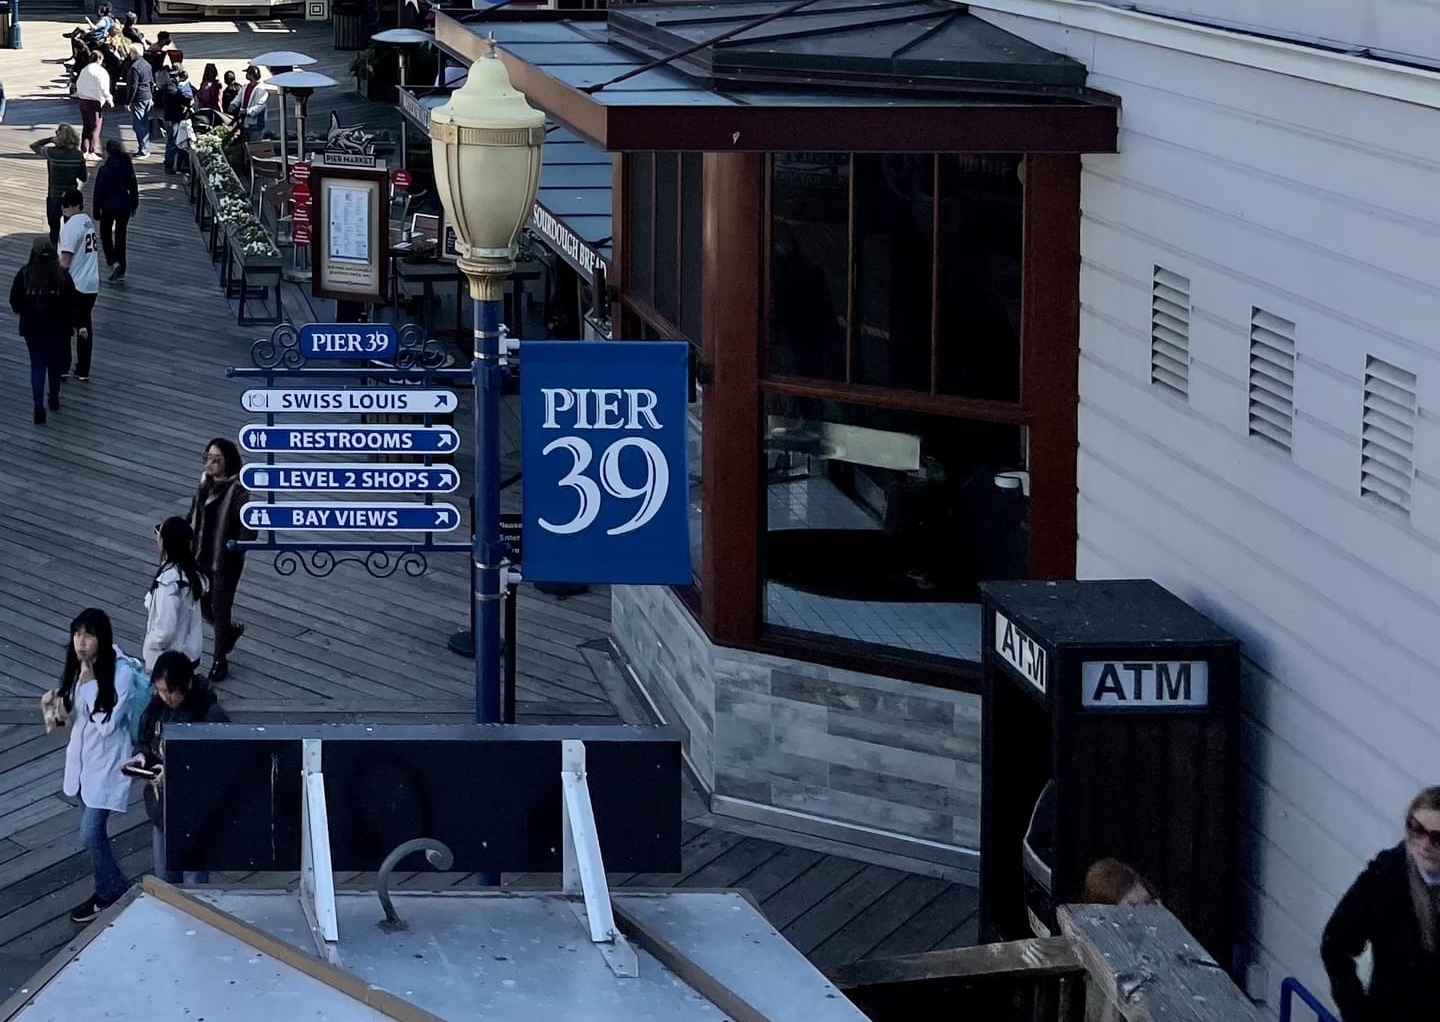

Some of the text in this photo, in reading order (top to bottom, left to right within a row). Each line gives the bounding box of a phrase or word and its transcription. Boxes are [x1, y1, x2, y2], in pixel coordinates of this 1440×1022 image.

[326, 154, 374, 165] PIER MARKET
[533, 203, 579, 261] SOURDOUGH
[85, 232, 98, 254] 28
[311, 332, 389, 352] PIER 39
[282, 393, 408, 409] SWISS LOUIS
[540, 388, 664, 430] PIER
[289, 431, 413, 449] RESTROOMS
[279, 471, 429, 488] LEVEL 2 SHOPS
[537, 435, 670, 536] 39
[292, 510, 399, 527] BAY VIEWS
[1001, 619, 1045, 687] ATM
[1092, 663, 1192, 701] ATM
